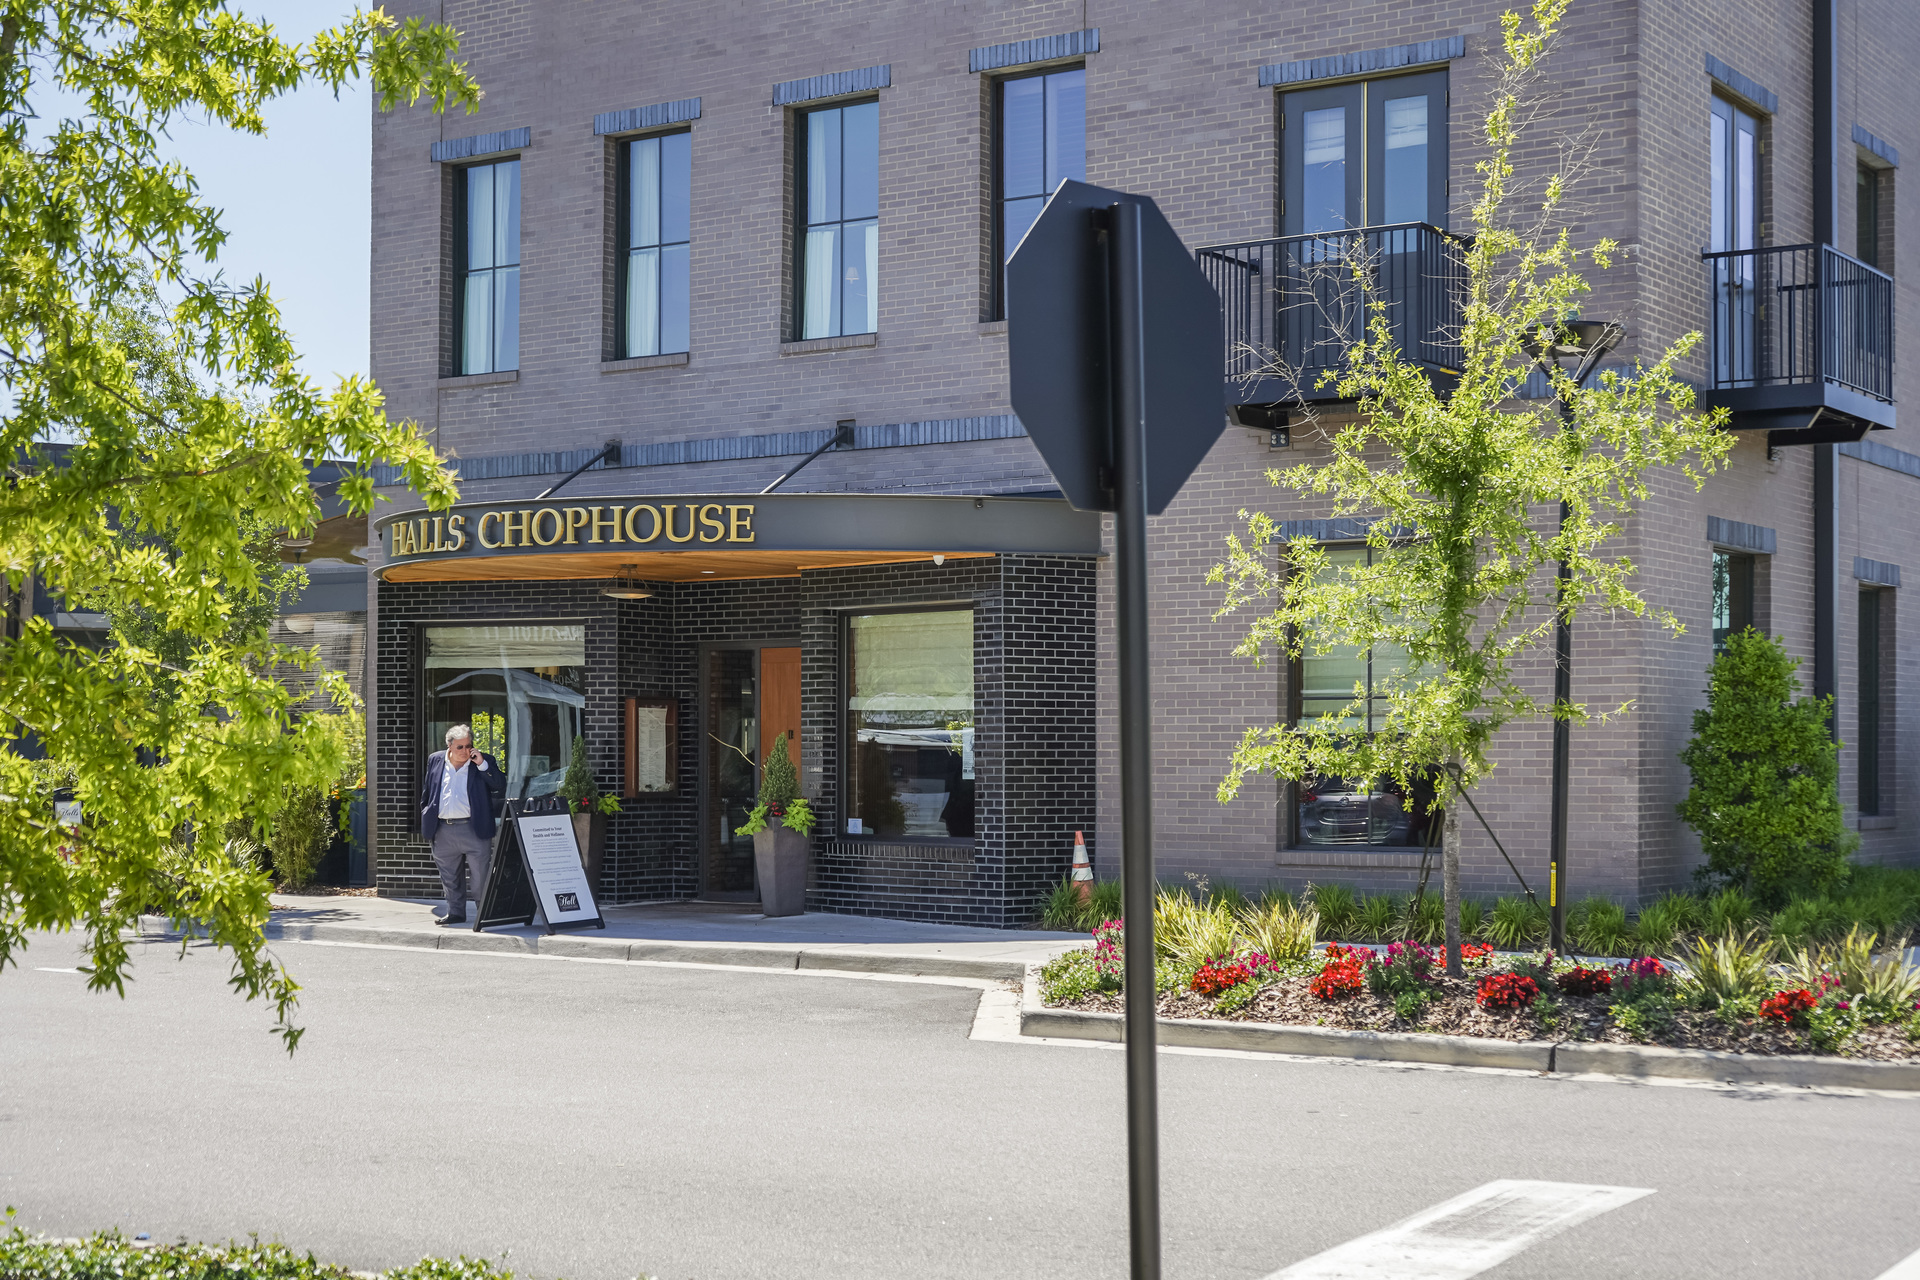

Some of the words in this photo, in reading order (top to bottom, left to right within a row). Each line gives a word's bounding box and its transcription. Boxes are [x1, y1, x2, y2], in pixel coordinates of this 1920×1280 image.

[391, 514, 465, 557] HALLS
[477, 503, 755, 549] CHOPHOUSE
[60, 808, 79, 817] Halls
